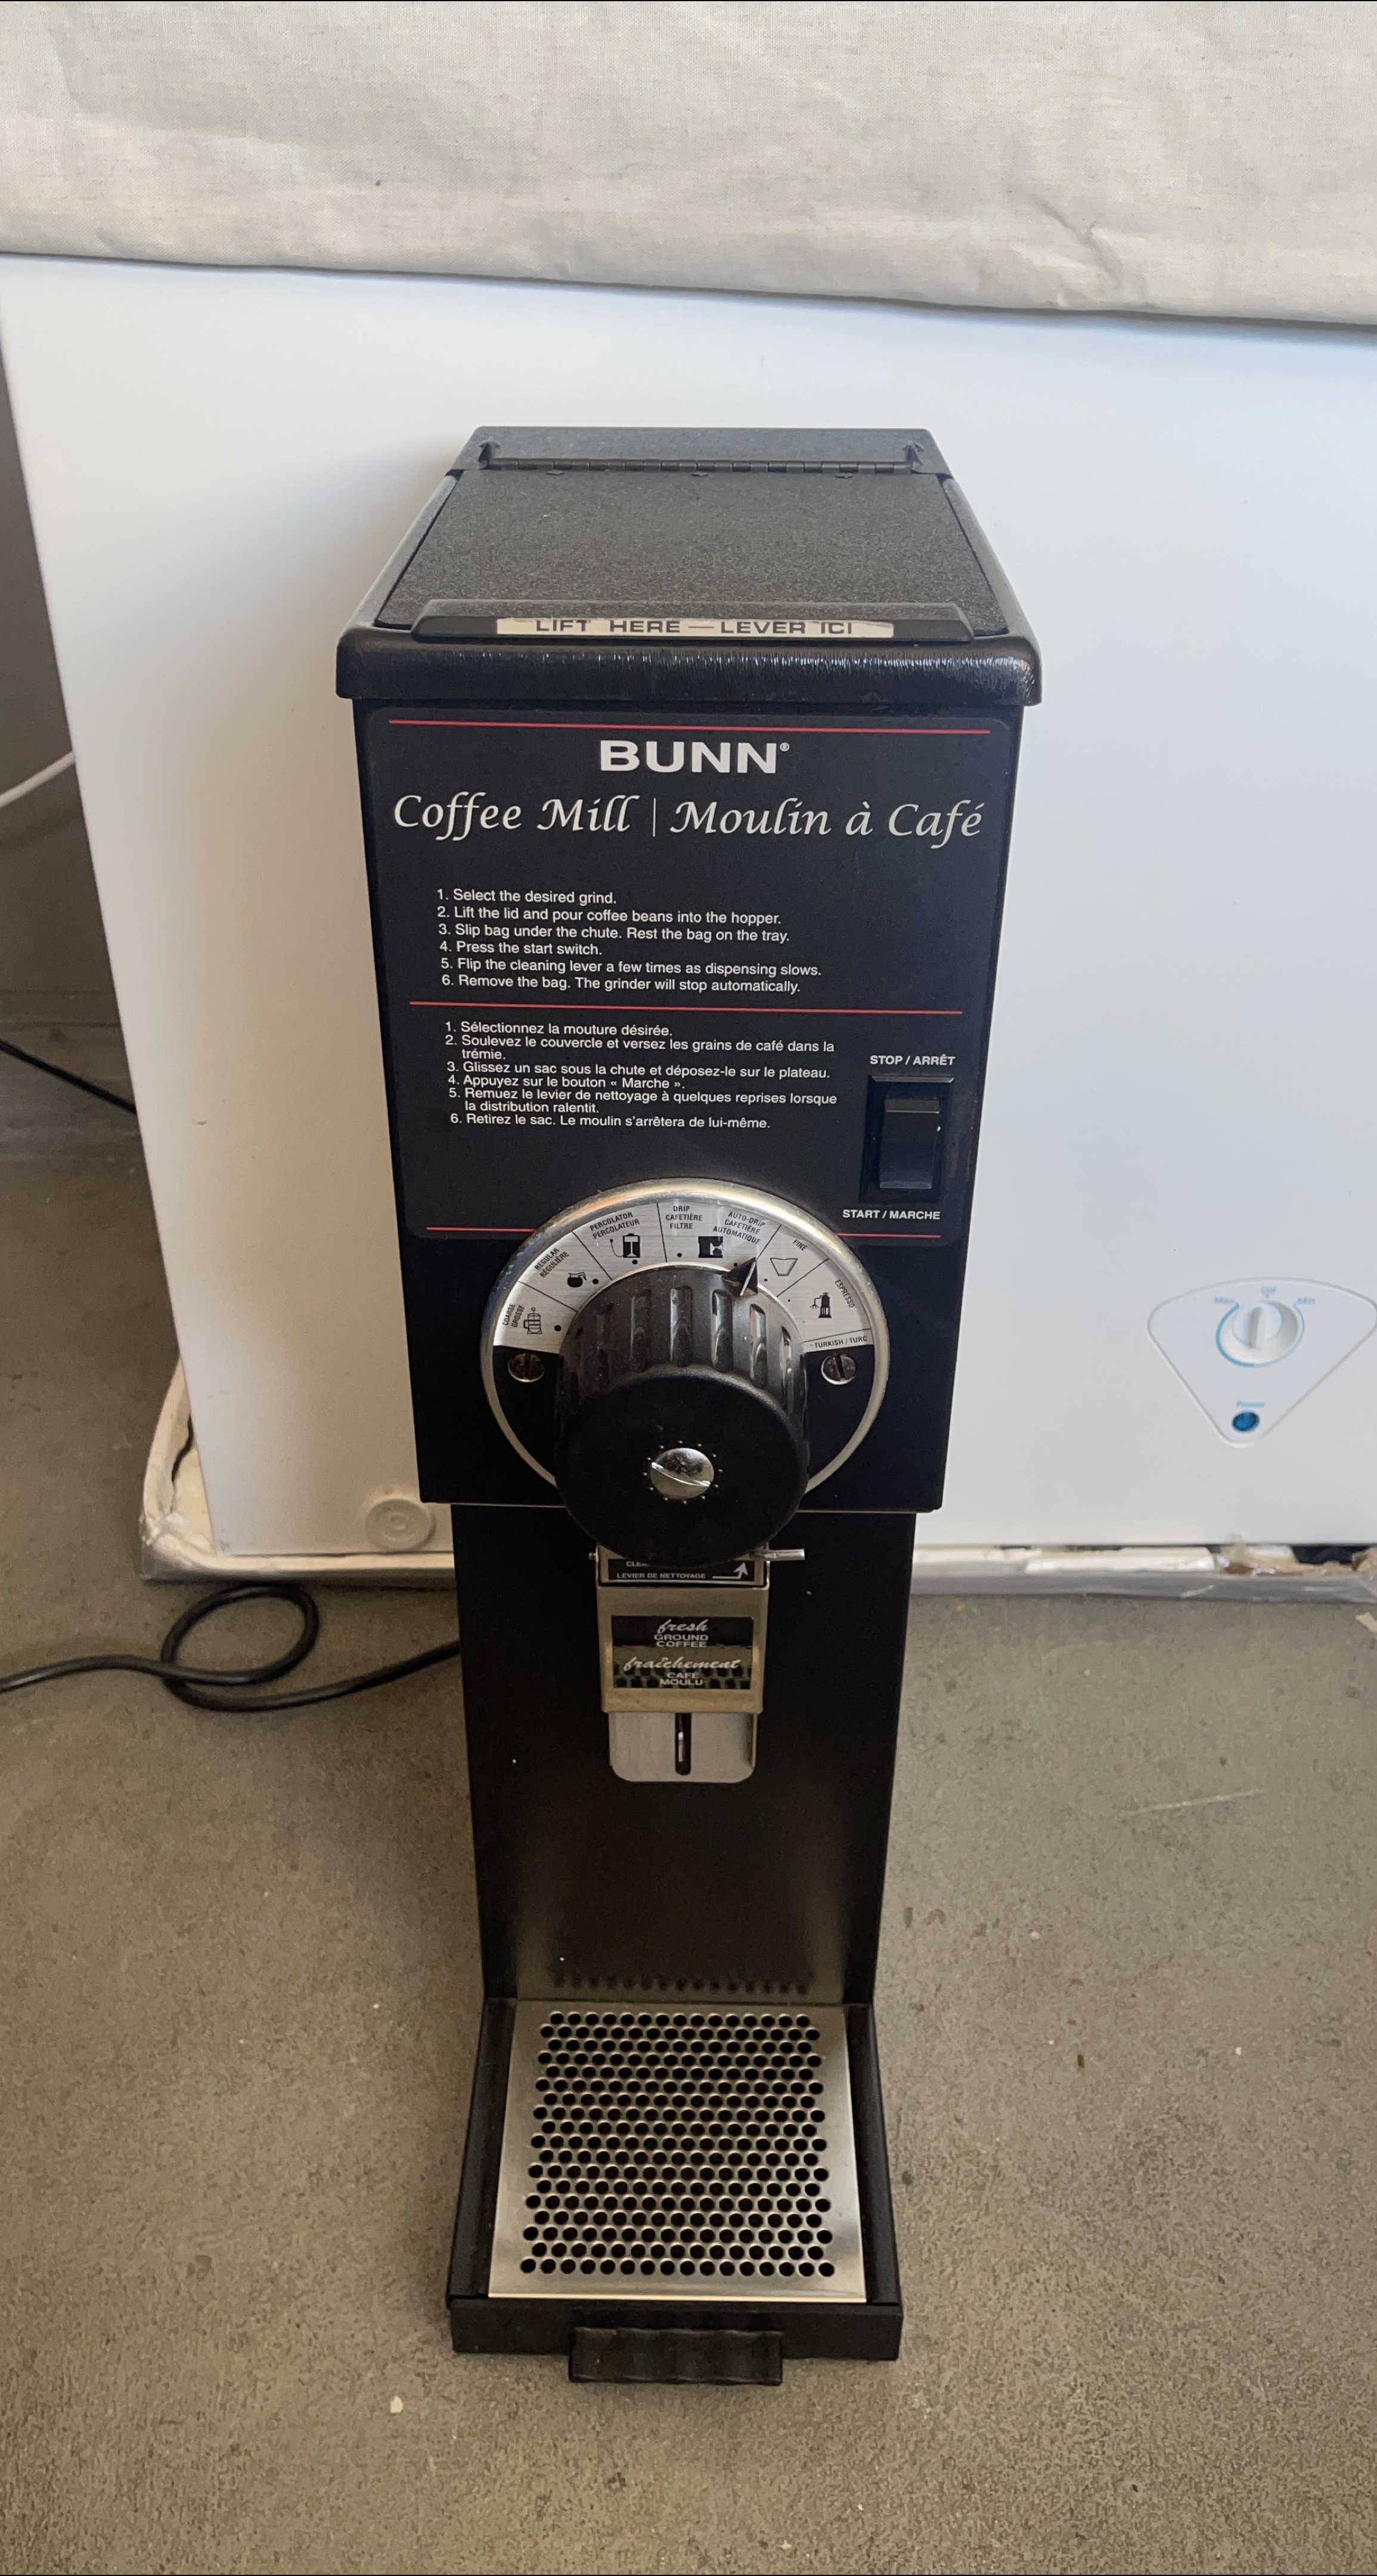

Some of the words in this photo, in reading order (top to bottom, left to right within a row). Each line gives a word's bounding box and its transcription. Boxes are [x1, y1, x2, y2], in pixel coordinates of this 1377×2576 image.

[536, 620, 587, 632] LIFT
[609, 620, 681, 633] HERE
[721, 621, 806, 634] LEVER
[820, 622, 852, 634] ICI
[394, 791, 522, 841] Coffee
[536, 795, 640, 832] Mill
[669, 797, 832, 835] Moulin
[845, 801, 873, 835] à
[888, 800, 985, 849] Café
[437, 888, 449, 900] 1.
[453, 888, 496, 902] Select
[499, 890, 521, 902] the
[525, 890, 575, 903] desired
[579, 891, 616, 906] grind.
[437, 906, 450, 918] 2.
[454, 906, 475, 918] Lift
[478, 907, 500, 919] the
[504, 907, 519, 919] lid
[523, 908, 548, 920] and
[553, 911, 584, 923] pour
[587, 909, 628, 922] coffee
[632, 910, 673, 922] beans
[678, 911, 702, 923] into
[706, 911, 727, 924] the
[731, 911, 781, 927] hopper.
[439, 923, 451, 935] 3.
[455, 923, 480, 938] Slip
[484, 924, 510, 939] bag
[514, 925, 553, 937] under
[556, 925, 578, 938] the
[581, 926, 622, 939] chute.
[627, 927, 658, 939] Rest
[661, 927, 683, 940] the
[687, 928, 712, 943] bag
[715, 931, 733, 940] on
[736, 929, 758, 941] the
[762, 930, 789, 945] tray.
[439, 940, 452, 952] 4.
[456, 940, 495, 953] Press
[498, 942, 519, 953] the
[523, 943, 553, 954] start
[557, 943, 602, 955] switch.
[441, 957, 453, 969] 5.
[458, 957, 482, 972] Flip
[485, 958, 506, 970] the
[510, 959, 566, 974] cleaning
[570, 960, 603, 972] lever
[606, 963, 615, 973] a
[618, 961, 642, 973] few
[645, 961, 681, 974] times
[686, 964, 701, 974] as
[705, 962, 777, 978] dispensing
[780, 964, 821, 976] slows.
[442, 974, 454, 986] 6.
[458, 974, 514, 987] Remove
[517, 976, 538, 987] the
[542, 976, 570, 991] bag.
[574, 977, 600, 989] The
[604, 978, 652, 992] grinder
[654, 979, 675, 990] will
[679, 980, 708, 993] stop
[711, 980, 800, 995] automatically.
[445, 1021, 456, 1032] 1.
[461, 1021, 544, 1034] Sélectionnez
[548, 1023, 560, 1034] la
[563, 1024, 617, 1035] mouture
[621, 1024, 672, 1036] désirée.
[445, 1034, 457, 1045] 2.
[461, 1034, 522, 1046] Soulevez
[525, 1036, 536, 1047] le
[540, 1037, 603, 1048] couvercle
[606, 1038, 619, 1049] et
[623, 1040, 666, 1049] versez
[670, 1039, 688, 1050] les
[692, 1039, 732, 1052] grains
[736, 1040, 752, 1051] de
[756, 1040, 784, 1051] café
[787, 1041, 819, 1052] dans
[823, 1041, 835, 1052] la
[461, 1048, 506, 1060] trémie.
[870, 1055, 903, 1065] STOP
[913, 1054, 956, 1066] ARRÊT
[447, 1061, 459, 1072] 3.
[463, 1061, 510, 1073] Glissez
[514, 1064, 531, 1073] un
[534, 1065, 557, 1074] sac
[561, 1066, 591, 1075] sous
[596, 1064, 607, 1075] la
[610, 1064, 646, 1075] chute
[649, 1065, 662, 1076] et
[665, 1064, 736, 1079] déposez-le
[740, 1068, 761, 1077] sur
[764, 1066, 776, 1078] le
[779, 1067, 830, 1080] plateau.
[448, 1075, 460, 1085] 4.
[463, 1075, 519, 1088] Appuyez
[523, 1078, 544, 1086] sur
[547, 1076, 558, 1087] le
[562, 1076, 606, 1088] bouton
[622, 1077, 669, 1089] Marche
[449, 1087, 460, 1098] 5.
[465, 1087, 518, 1099] Remuez
[522, 1088, 533, 1100] le
[536, 1088, 572, 1100] levier
[575, 1089, 591, 1100] de
[595, 1091, 658, 1104] nettoyage
[661, 1090, 669, 1101] à
[673, 1091, 731, 1105] quelques
[736, 1094, 786, 1105] reprises
[790, 1092, 837, 1106] lorsque
[465, 1100, 476, 1111] la
[480, 1100, 549, 1112] distribution
[553, 1102, 599, 1113] ralentit.
[450, 1113, 462, 1123] 6.
[466, 1113, 511, 1125] Retirez
[515, 1114, 526, 1125] le
[530, 1116, 556, 1125] sac.
[560, 1114, 576, 1126] Le
[579, 1115, 621, 1126] moulin
[688, 1117, 705, 1128] de
[709, 1117, 770, 1128] lui-même.
[589, 1212, 634, 1231] PERCOLATOR
[665, 1213, 703, 1221] CAFETIÈRE
[727, 1212, 766, 1227] AUTO-DRIP
[842, 1209, 880, 1219] START
[889, 1210, 941, 1220] MARCHE
[592, 1219, 640, 1240] PERCOLATEUR
[713, 1226, 761, 1245] AUTOMATIQUE
[724, 1219, 761, 1235] CAFETIÈRE
[792, 1239, 808, 1252] FINE
[534, 1247, 560, 1271] REGULAR
[835, 1279, 855, 1308] ESPRESSO
[502, 1304, 516, 1326] COARSE
[511, 1304, 525, 1328] GROSSE
[814, 1339, 843, 1349] TURKISH
[849, 1335, 868, 1343] TURC
[656, 1618, 709, 1634] fresh
